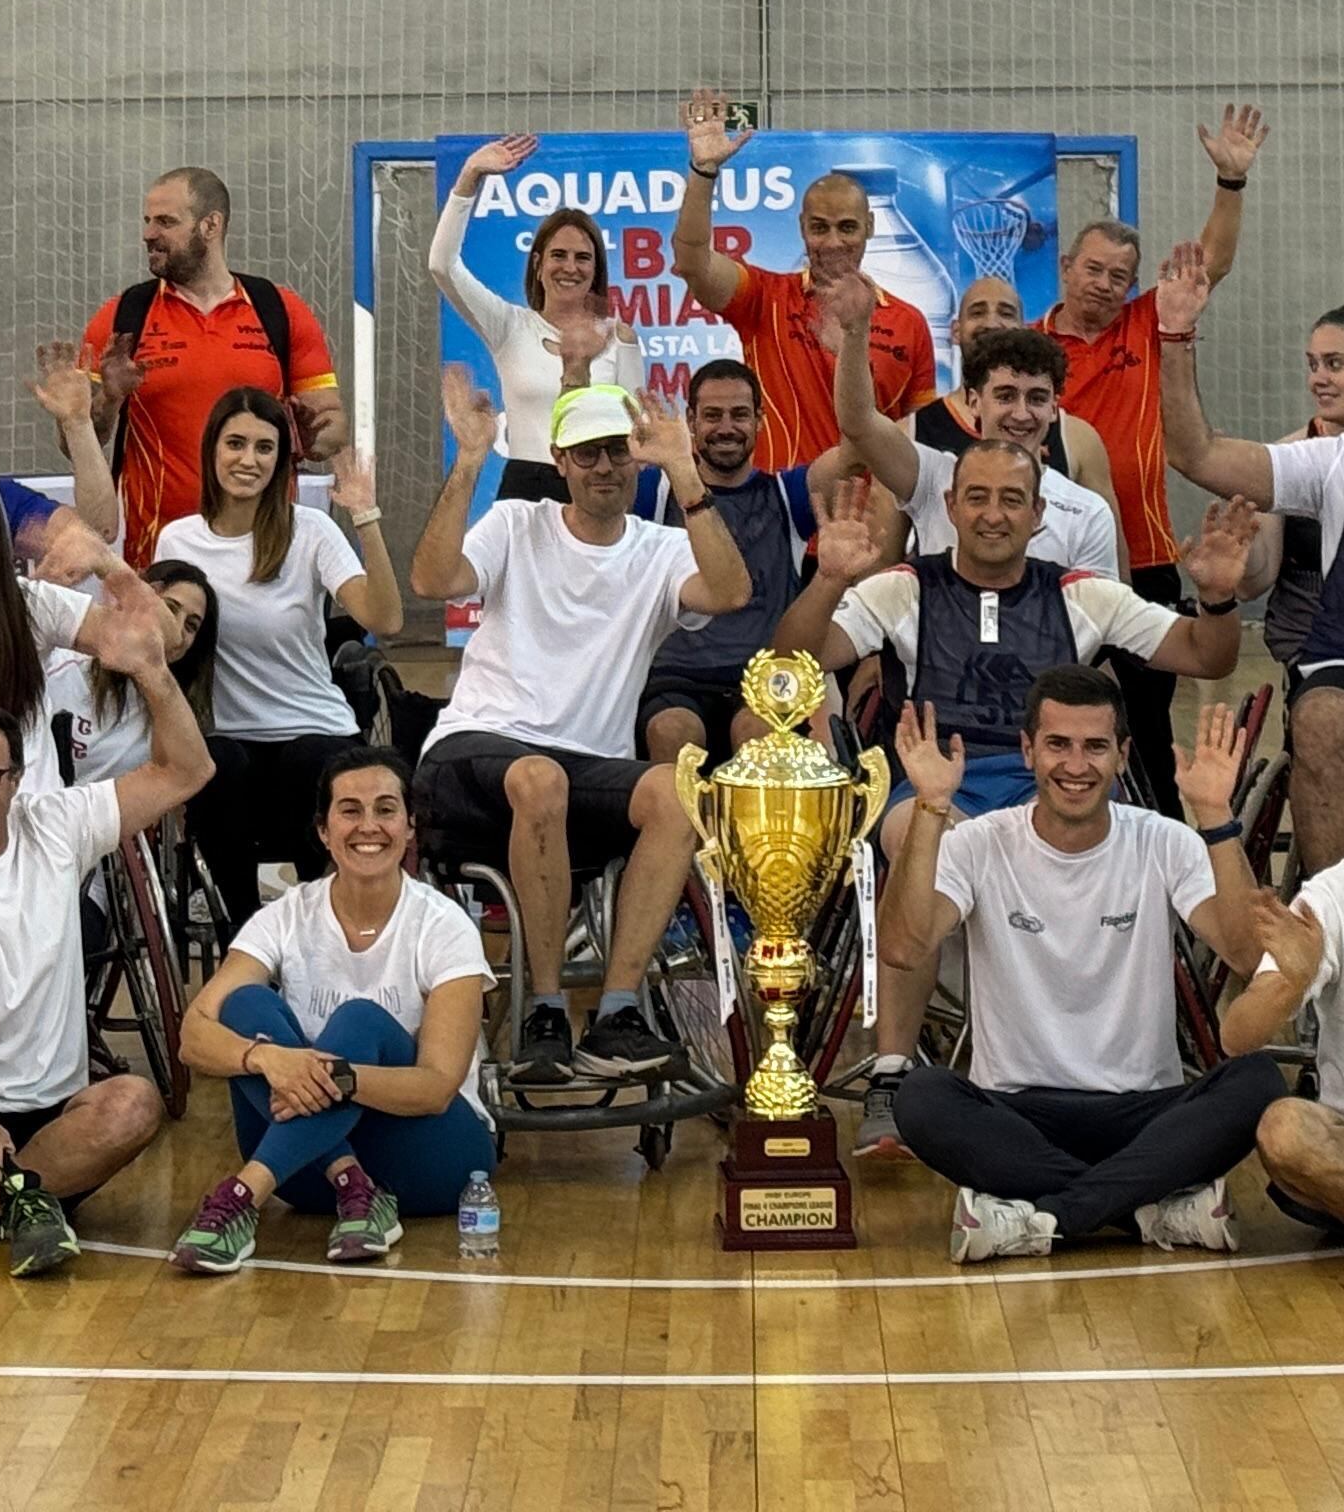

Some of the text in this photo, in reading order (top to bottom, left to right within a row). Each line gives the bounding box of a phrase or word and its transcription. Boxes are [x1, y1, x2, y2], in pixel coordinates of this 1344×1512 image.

[474, 166, 795, 218] AQUADUS
[622, 225, 753, 279] BR
[607, 284, 730, 327] MIA
[638, 335, 700, 357] ASTA
[308, 985, 402, 1018] HUMIND
[744, 1212, 833, 1227] CHAMPION
